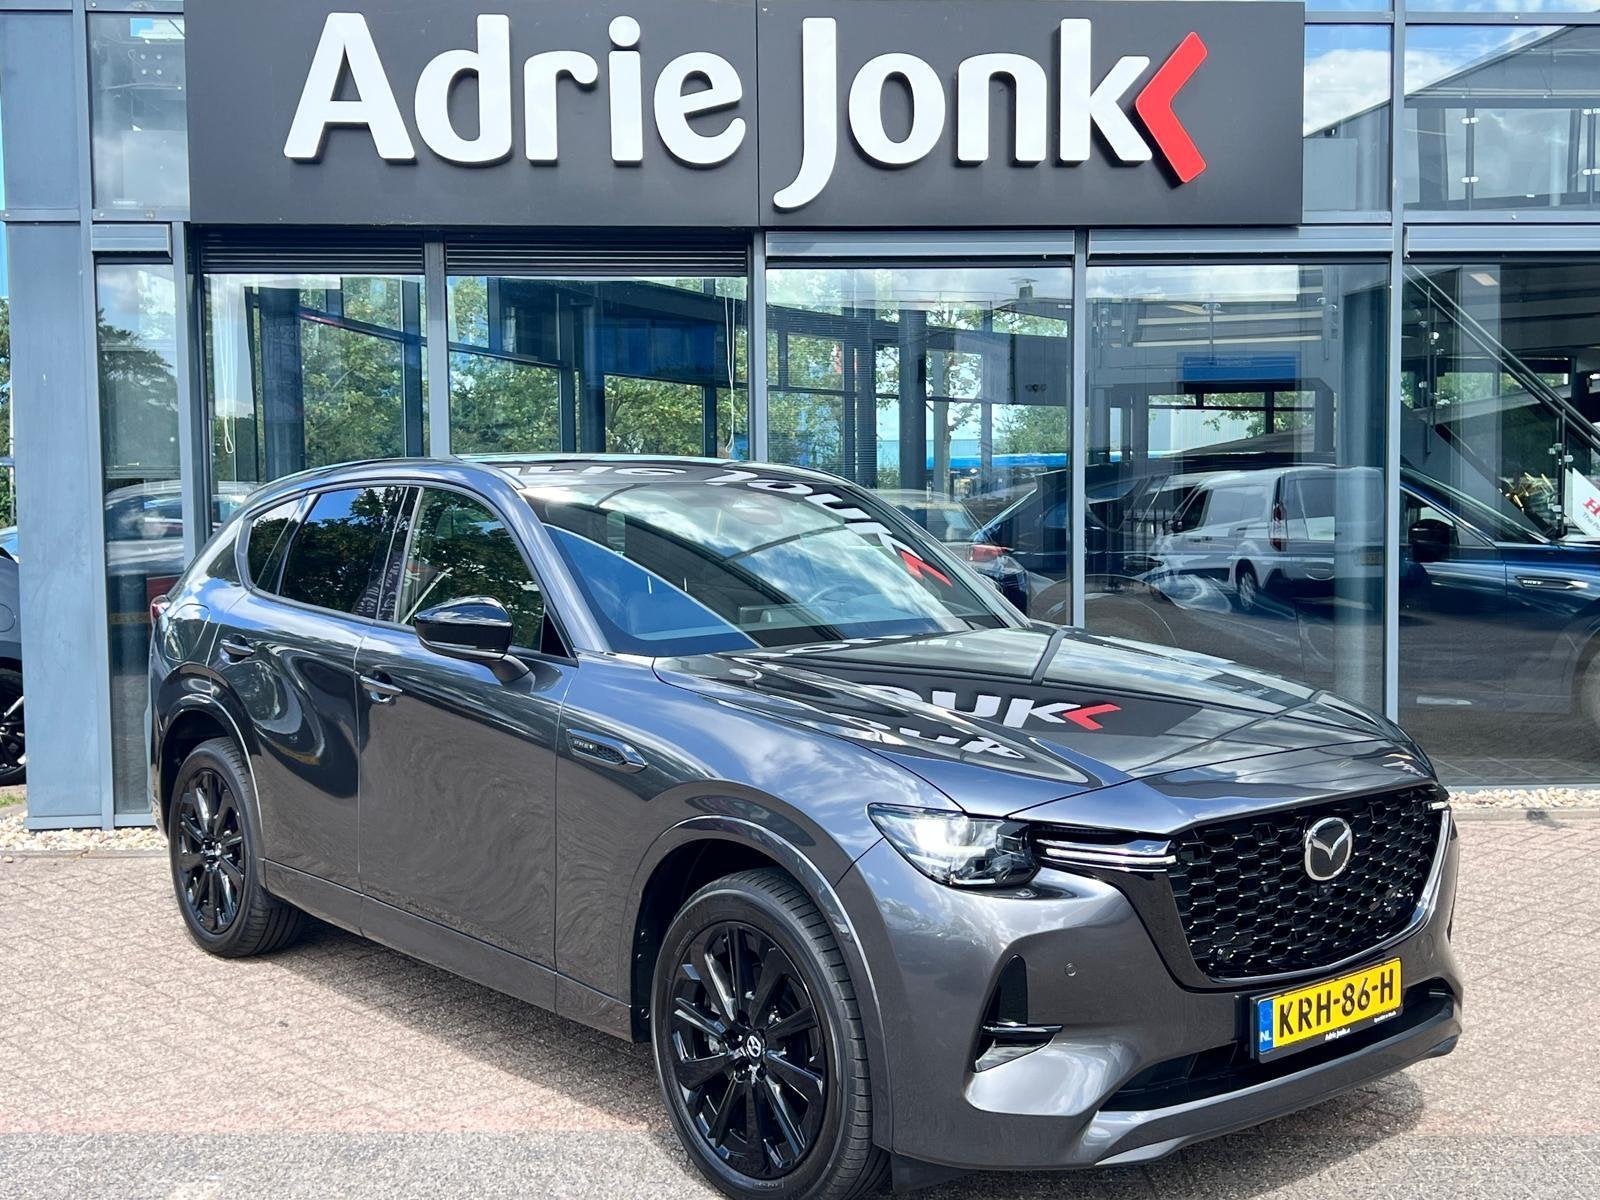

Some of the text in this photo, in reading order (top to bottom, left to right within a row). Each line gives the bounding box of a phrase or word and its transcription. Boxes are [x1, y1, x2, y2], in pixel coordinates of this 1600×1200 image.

[283, 12, 1153, 209] Adrie Jonk
[1260, 1030, 1272, 1043] NL
[1280, 969, 1394, 1038] KRH-86-H
